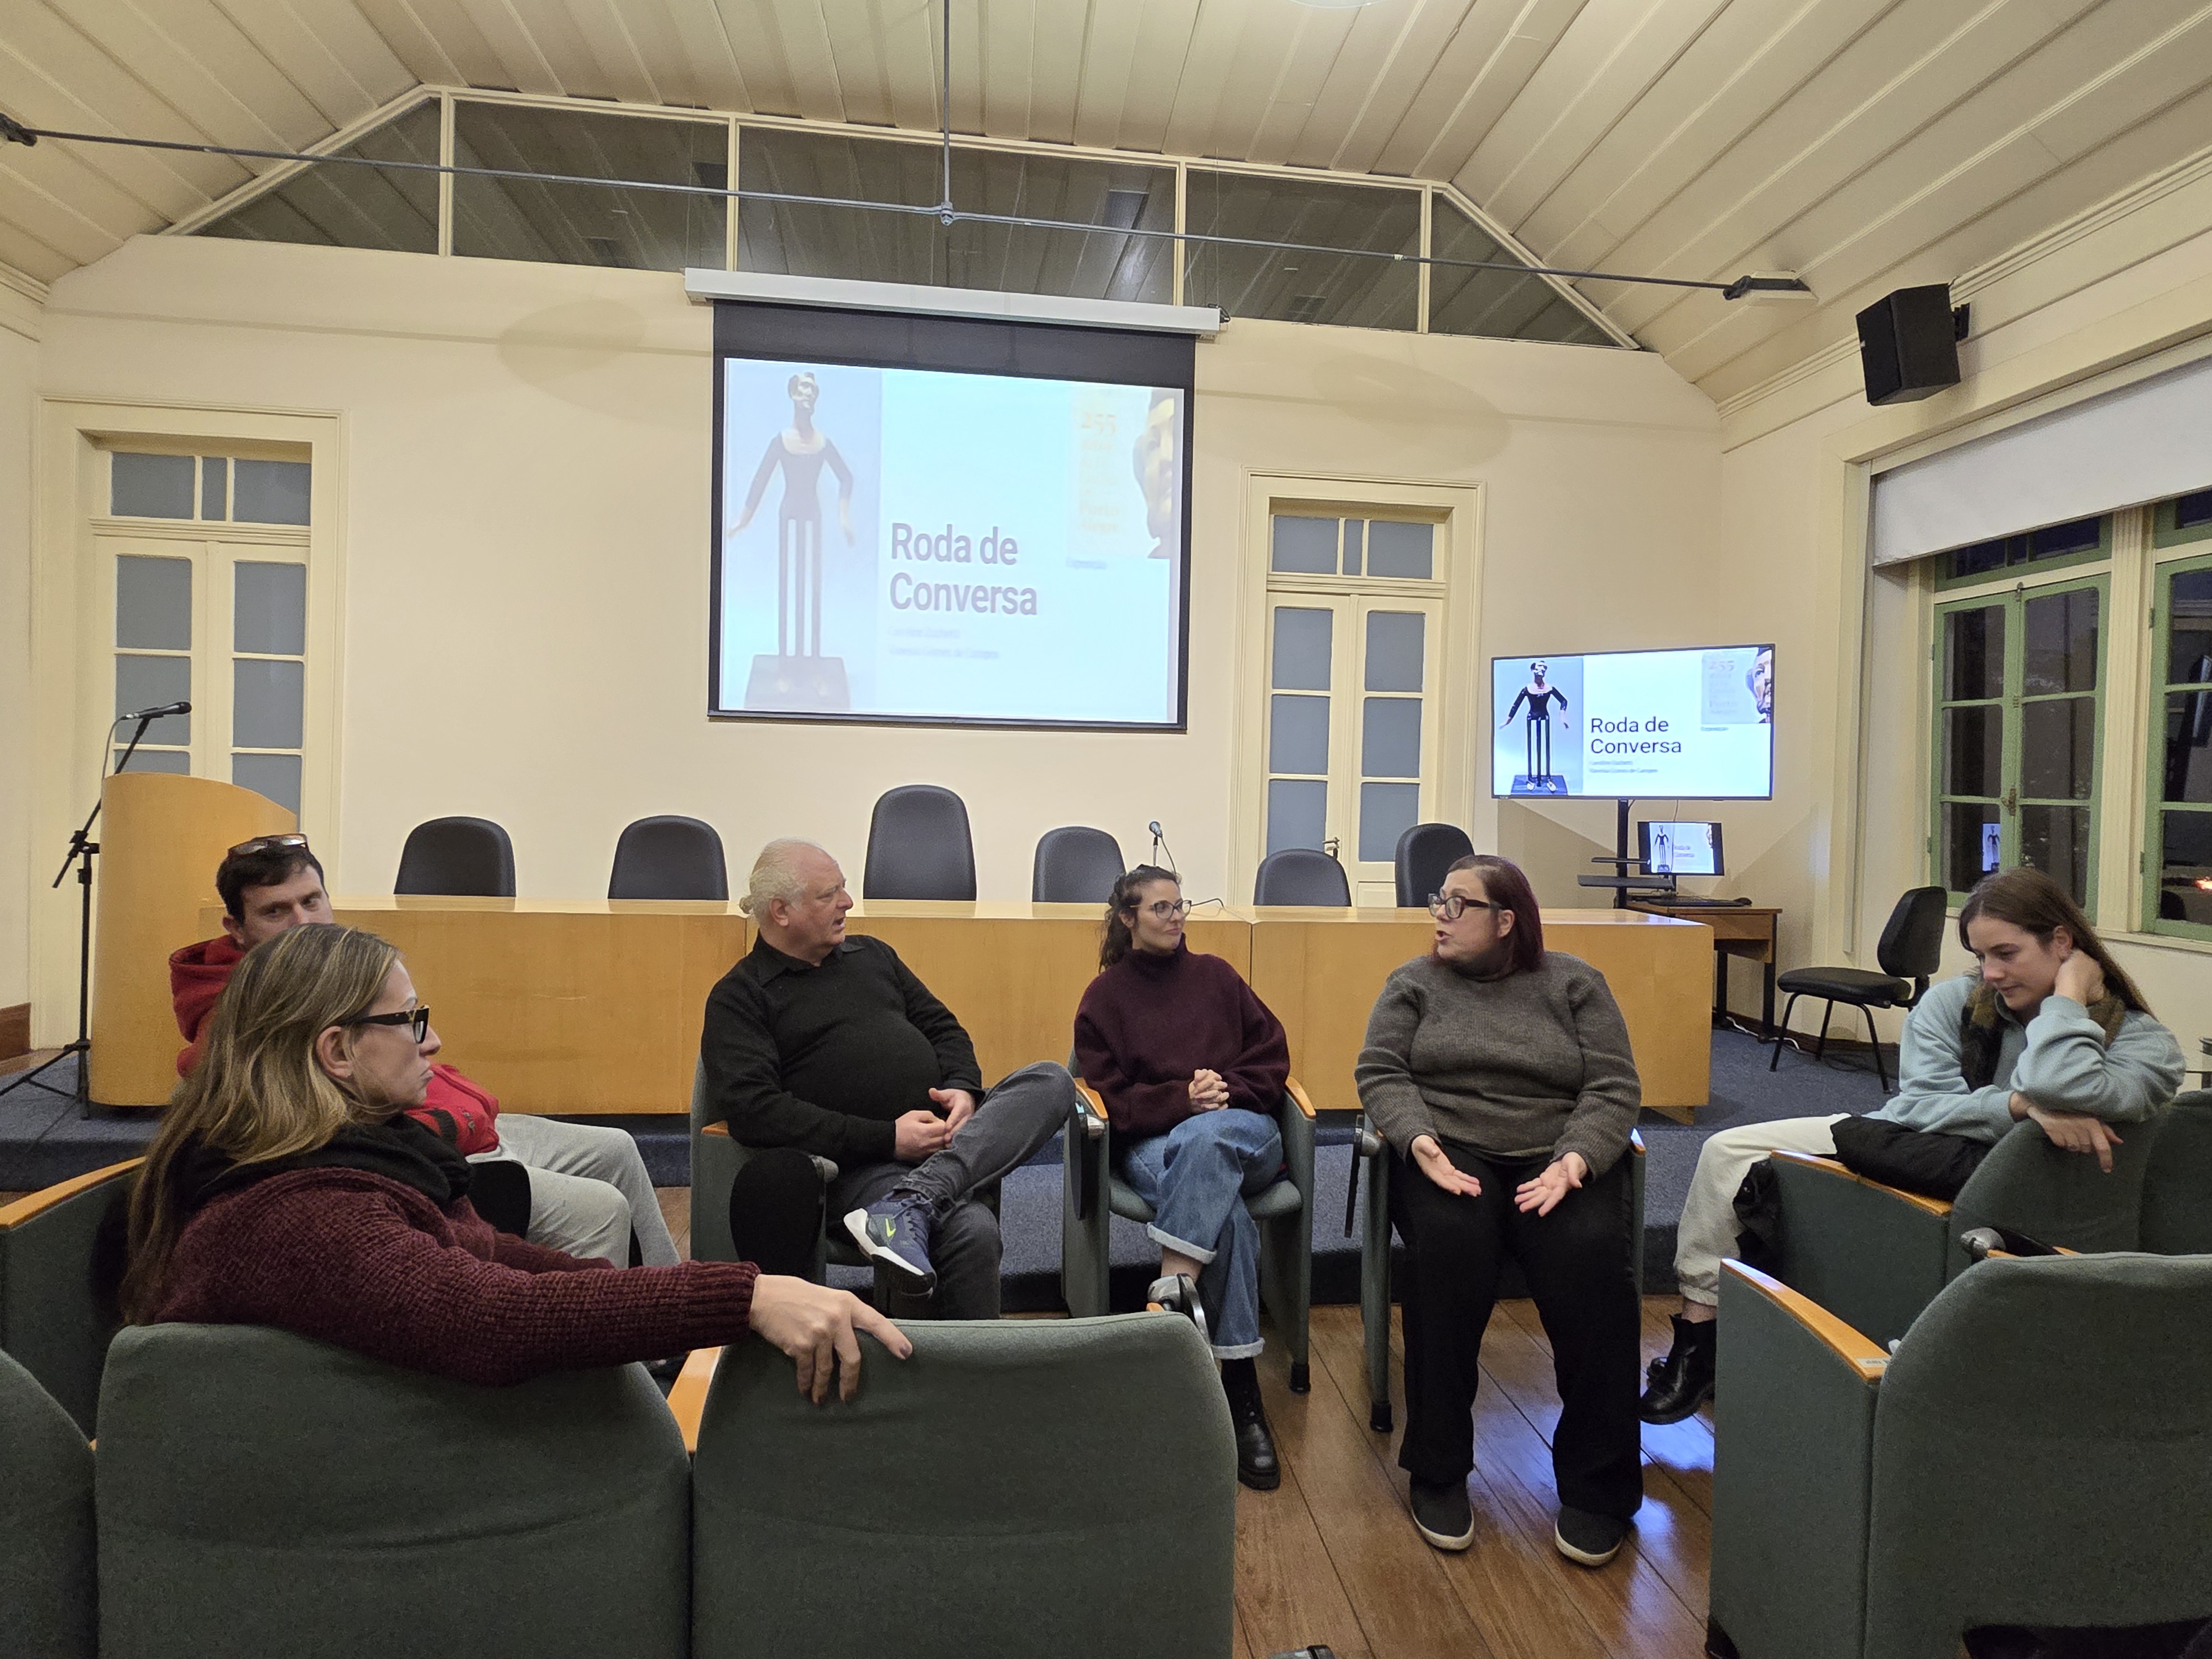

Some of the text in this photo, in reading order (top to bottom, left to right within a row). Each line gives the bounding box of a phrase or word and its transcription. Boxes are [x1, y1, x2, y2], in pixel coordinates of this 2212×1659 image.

[891, 523, 1018, 565] Roda de
[890, 572, 1037, 615] Conversa
[1591, 716, 1669, 733] Roda de
[1591, 739, 1681, 754] Conversa
